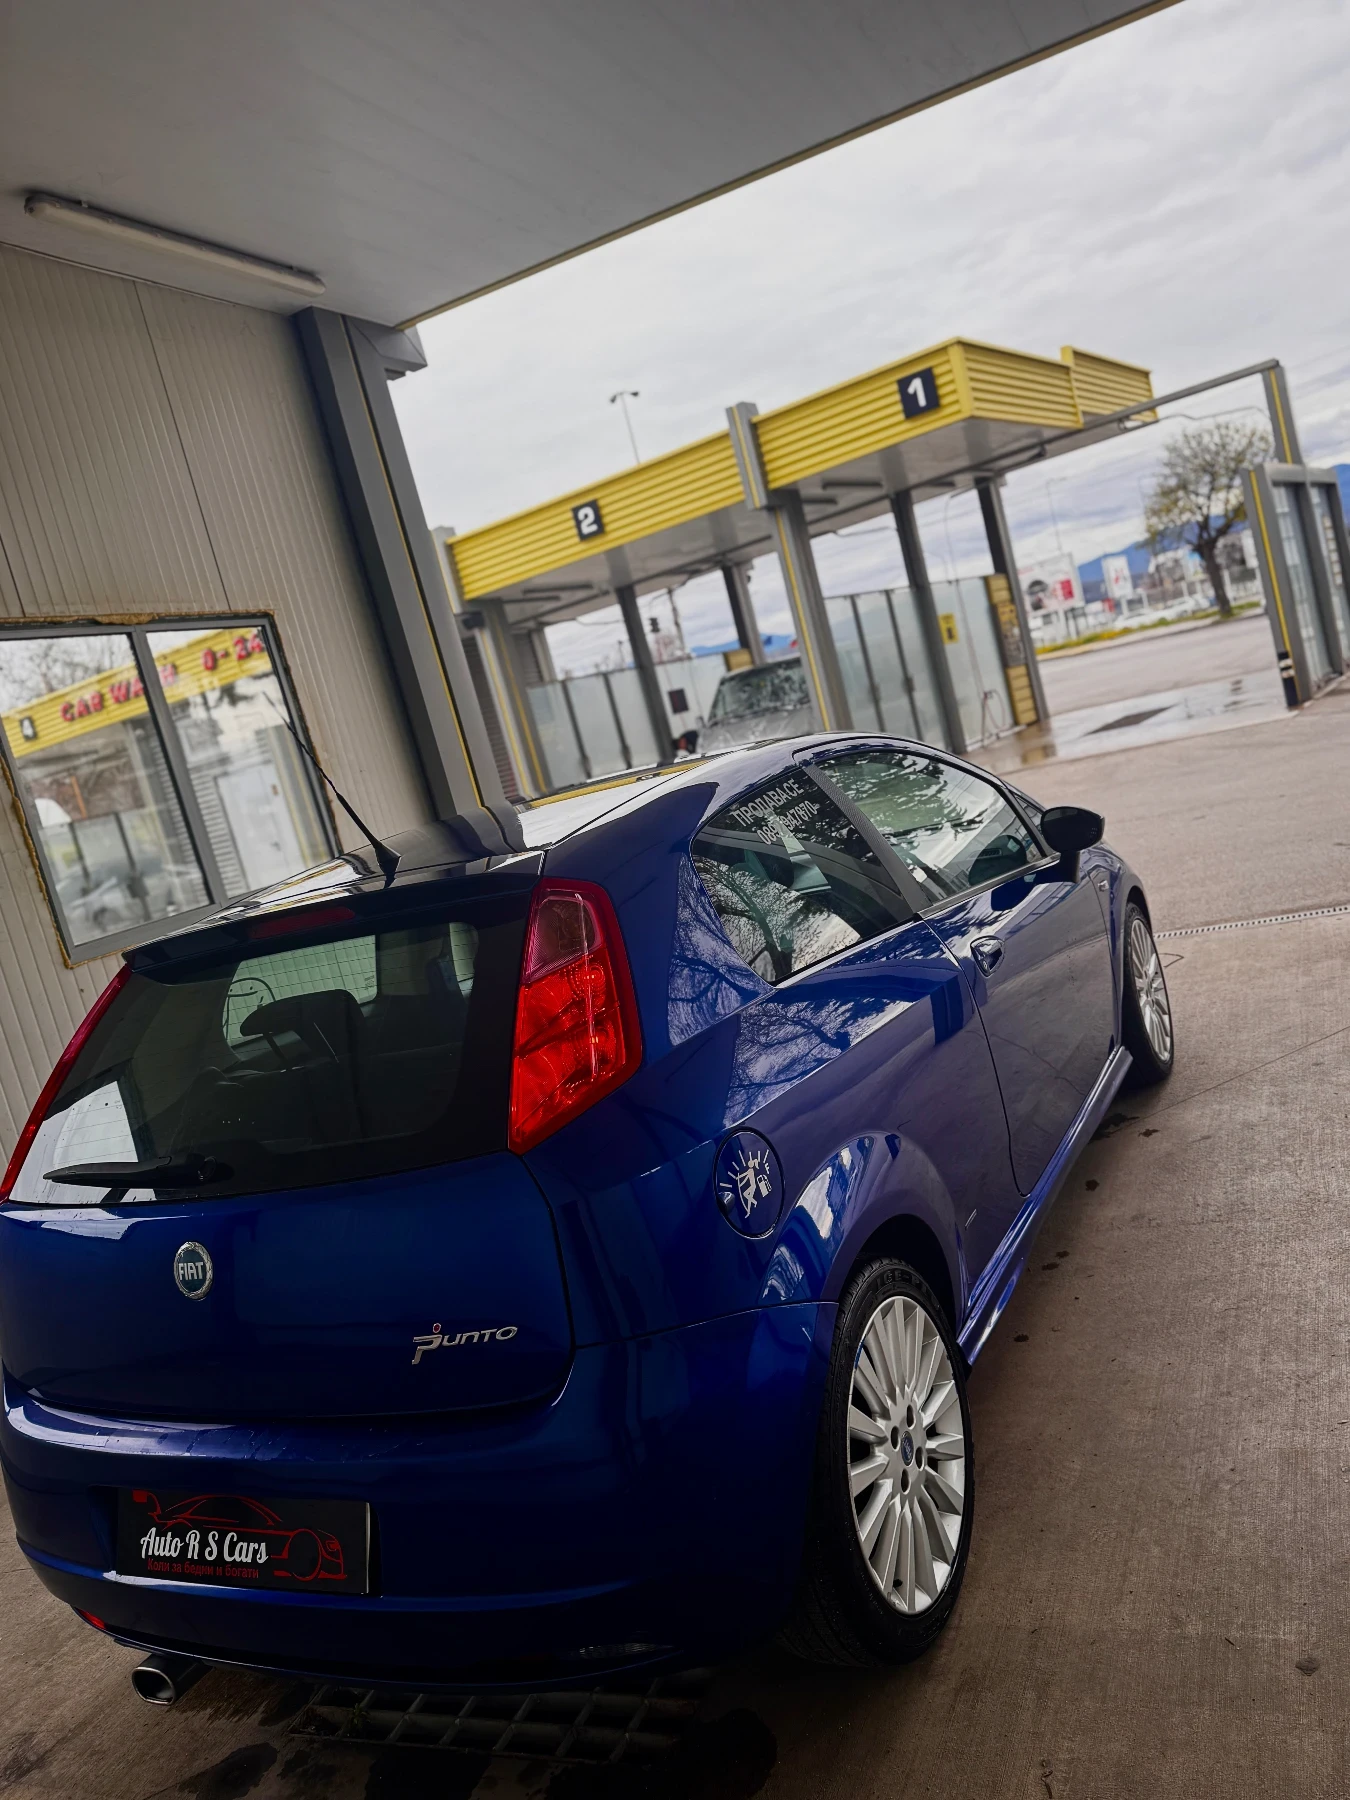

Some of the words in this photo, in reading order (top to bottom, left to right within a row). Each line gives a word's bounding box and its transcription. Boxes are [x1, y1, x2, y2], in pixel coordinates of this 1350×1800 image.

[906, 376, 928, 408] 1
[577, 505, 598, 535] 2
[60, 690, 104, 722] CAR
[108, 662, 176, 705] WAH
[178, 1261, 204, 1281] FIAT
[140, 1526, 185, 1559] Auto
[186, 1529, 201, 1560] R
[204, 1530, 219, 1561] S
[223, 1532, 269, 1564] Cars
[147, 1558, 170, 1572] Коли
[171, 1563, 182, 1573] за
[184, 1561, 214, 1576] бедни
[216, 1566, 223, 1576] и
[225, 1564, 259, 1579] богати
